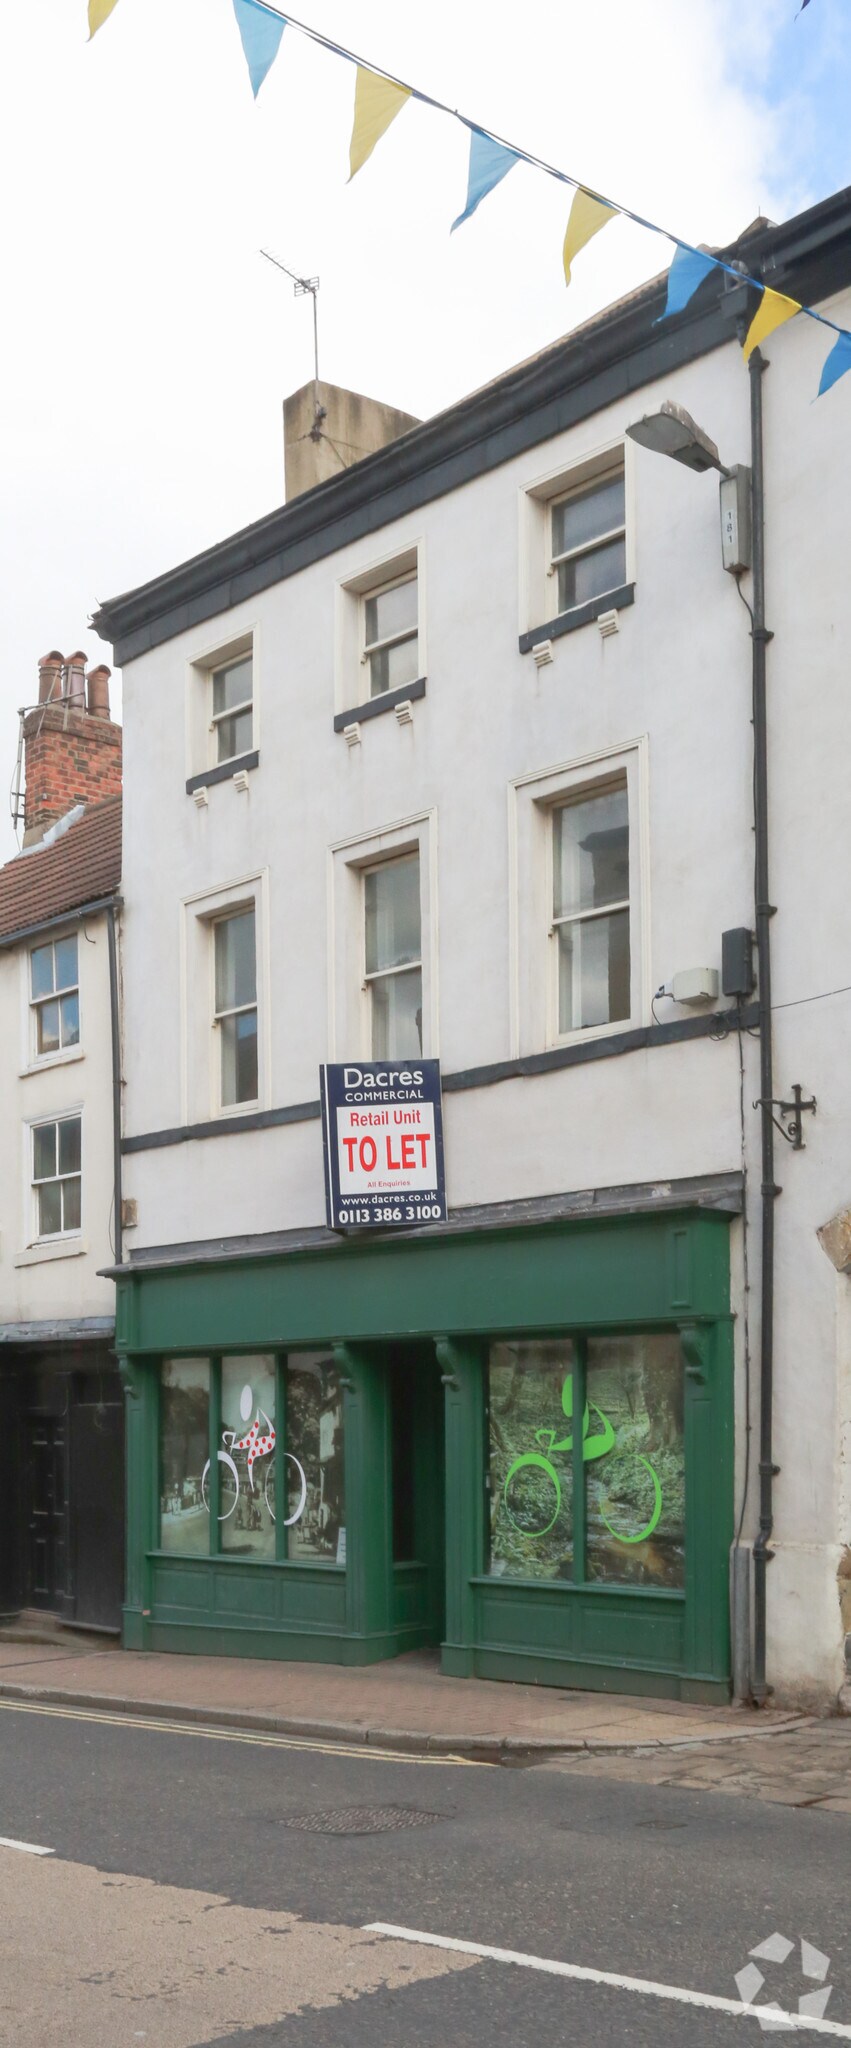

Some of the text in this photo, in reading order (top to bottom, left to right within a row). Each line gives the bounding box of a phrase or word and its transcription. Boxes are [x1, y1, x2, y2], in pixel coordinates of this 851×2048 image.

[344, 1068, 424, 1088] Dacres
[345, 1089, 424, 1102] COMMERCIAL
[350, 1109, 421, 1127] Retail Unit
[342, 1133, 431, 1172] TO LET
[378, 1179, 411, 1188] Enquiries
[341, 1191, 437, 1206] www.dacres.co.uk
[338, 1204, 442, 1224] 0113 386 3100
